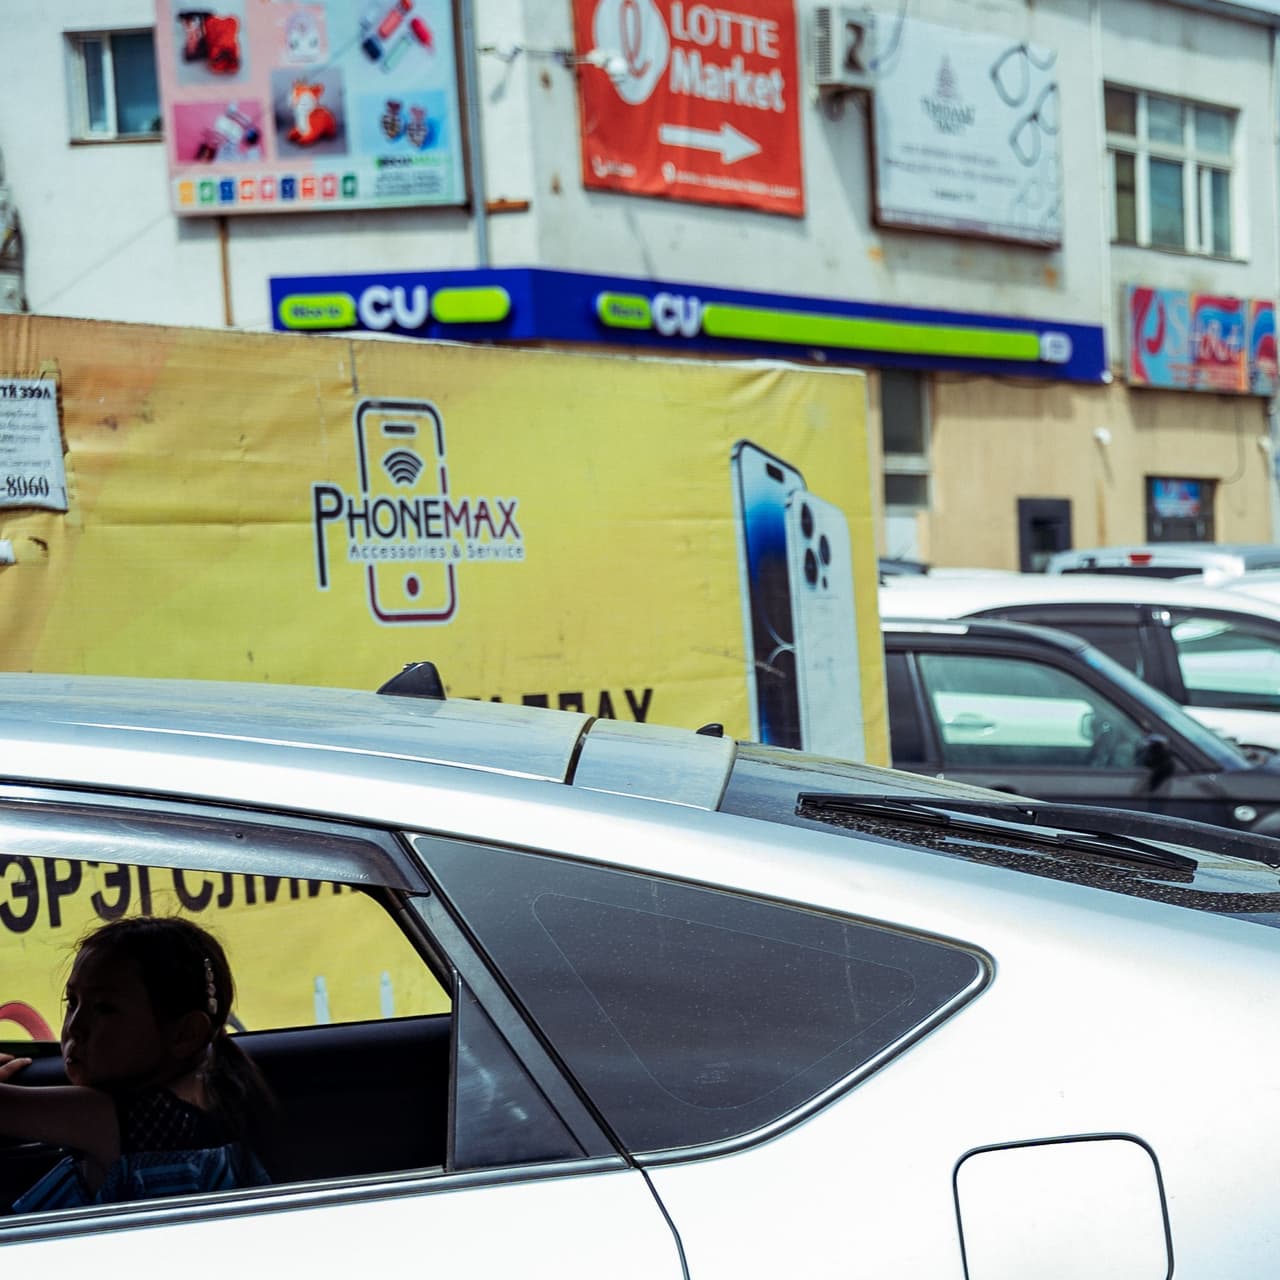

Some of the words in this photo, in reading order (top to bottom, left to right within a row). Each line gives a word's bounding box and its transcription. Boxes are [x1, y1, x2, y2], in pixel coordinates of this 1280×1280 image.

[669, 1, 780, 59] LOTTE
[669, 47, 785, 113] Market
[358, 284, 429, 331] CU
[651, 292, 701, 338] CU
[313, 485, 521, 587] PHONEMAX
[350, 544, 447, 560] Accessories
[452, 543, 461, 560] &
[466, 544, 524, 560] Service
